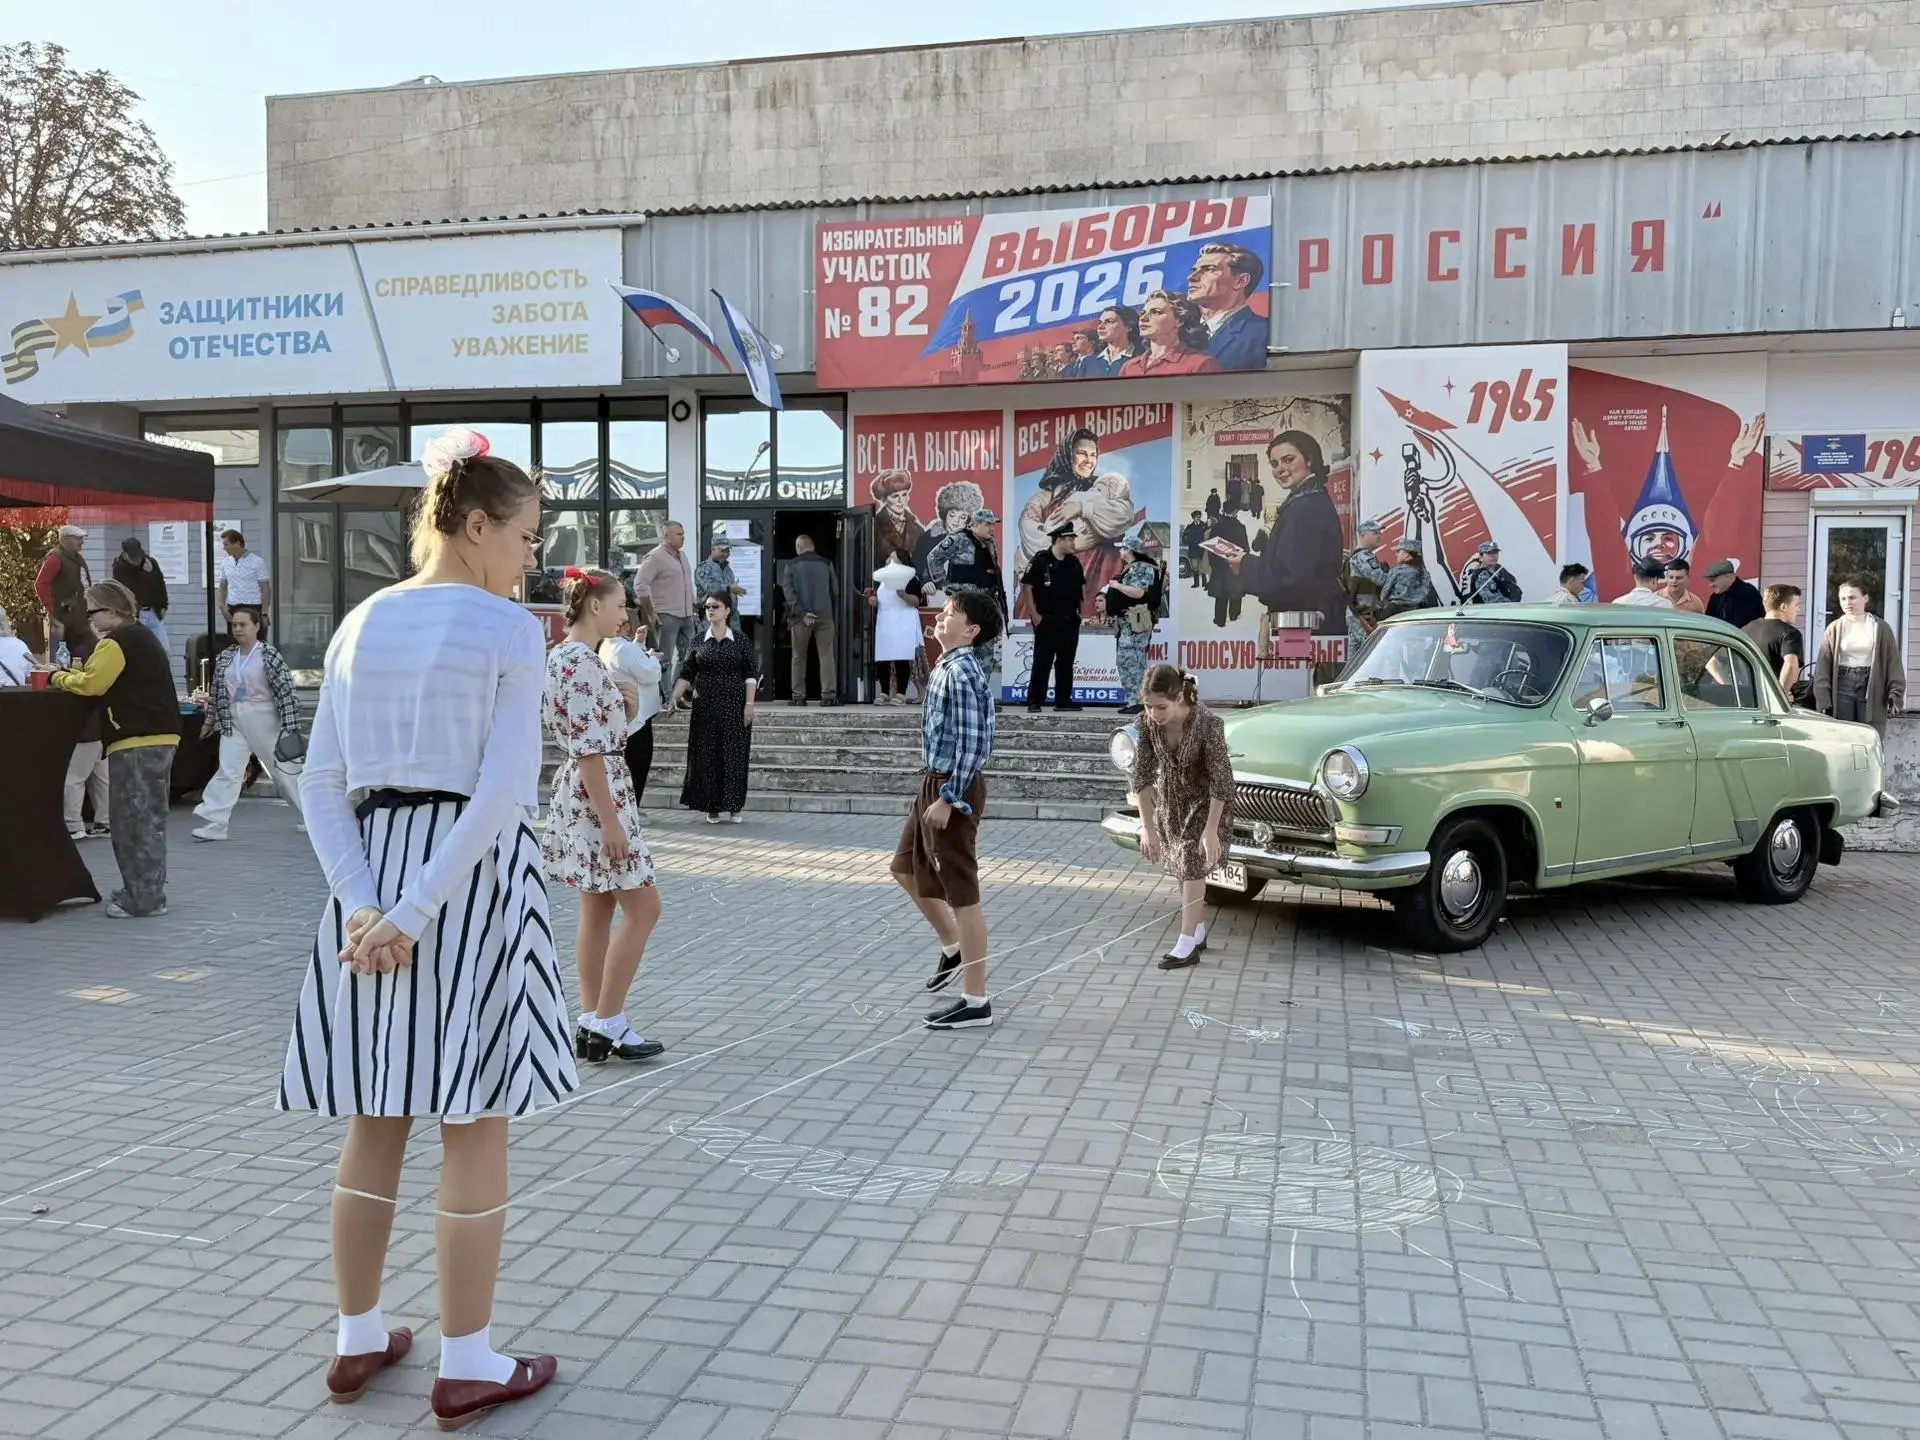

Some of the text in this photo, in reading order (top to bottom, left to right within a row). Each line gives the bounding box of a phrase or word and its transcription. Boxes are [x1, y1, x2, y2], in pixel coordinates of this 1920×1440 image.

[822, 220, 964, 252] ИЗБИРАТЕЛЬНЫЙ
[982, 196, 1248, 279] ВЫБОРЫ
[374, 268, 588, 298] СПРАВЕДЛИВОСТЬ
[822, 252, 932, 284] УЧАСТОК
[994, 251, 1168, 333] 2026
[159, 292, 344, 325] ЗАЩИТНИКИ
[491, 301, 589, 325] ЗАБОТА
[858, 285, 929, 338] 82
[168, 330, 333, 360] ОТЕЧЕСТВА
[451, 333, 589, 358] УВАЖЕНИЕ
[1466, 368, 1558, 434] 1965
[1018, 420, 1049, 457] ВСЕ
[1085, 403, 1167, 437] ВЫБОРЫ!
[857, 426, 1001, 474] ВСЕ НА ВЫБОРЫ!
[1641, 511, 1677, 522] СССР
[1178, 640, 1256, 669] ГОЛОСУЮ
[1011, 688, 1118, 700] МОЕНОЕ
